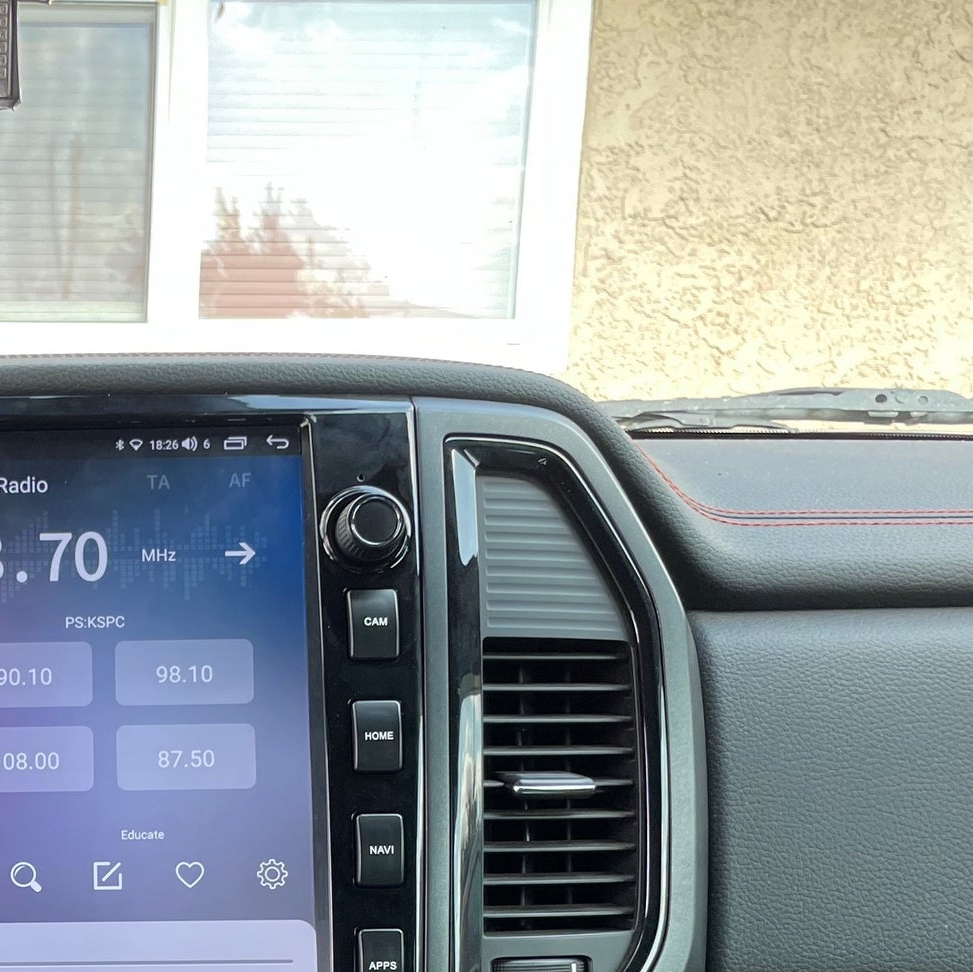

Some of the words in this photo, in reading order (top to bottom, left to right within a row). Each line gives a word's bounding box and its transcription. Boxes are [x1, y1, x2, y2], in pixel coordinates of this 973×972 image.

[149, 439, 179, 451] 18:26
[202, 438, 211, 450] 6
[146, 474, 170, 490] TA
[228, 472, 252, 488] AF
[141, 548, 176, 562] MHz
[64, 614, 126, 630] PS:KSPC
[363, 616, 388, 627] CAM
[155, 664, 214, 684] 98.10
[364, 730, 395, 741] HOME
[157, 749, 216, 769] 87.50
[120, 829, 165, 842] Educate
[368, 845, 395, 855] NAVI
[368, 961, 398, 971] APPS
